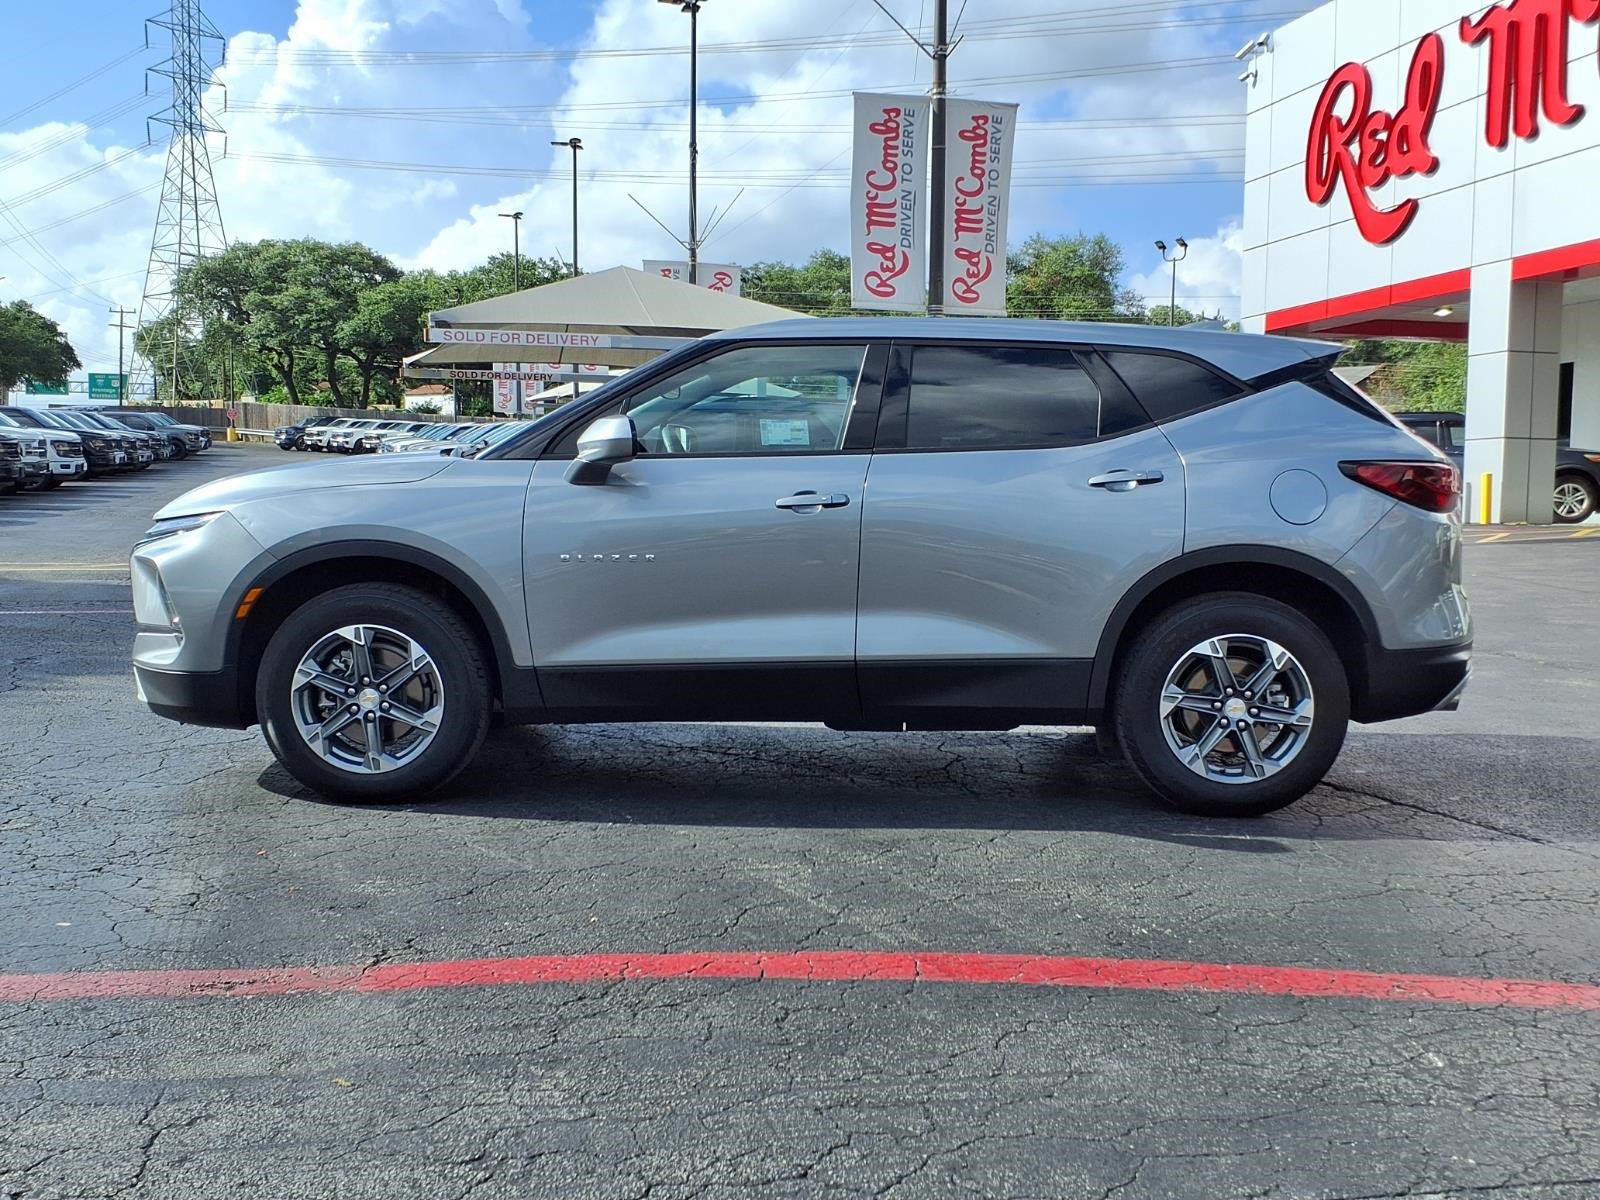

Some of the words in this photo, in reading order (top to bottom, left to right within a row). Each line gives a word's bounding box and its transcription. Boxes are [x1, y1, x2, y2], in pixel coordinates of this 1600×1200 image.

[902, 107, 915, 159] SERVE
[989, 114, 1003, 164] SERVE
[1305, 32, 1444, 246] Red
[865, 106, 902, 237] McCombs
[901, 163, 913, 185] TO
[953, 114, 990, 242] McCombs
[987, 169, 1000, 191] TO
[899, 189, 913, 249] DRIVEN
[984, 195, 998, 255] DRIVEN
[863, 241, 910, 298] Red
[951, 247, 992, 304] Red
[443, 330, 485, 343] SOLD
[490, 331, 520, 344] FOR
[526, 333, 600, 346] DELIVERY
[449, 370, 478, 379] SOLD
[480, 371, 503, 380] FOR
[506, 371, 553, 381] DELIVERY
[560, 554, 655, 563] BLAZER
